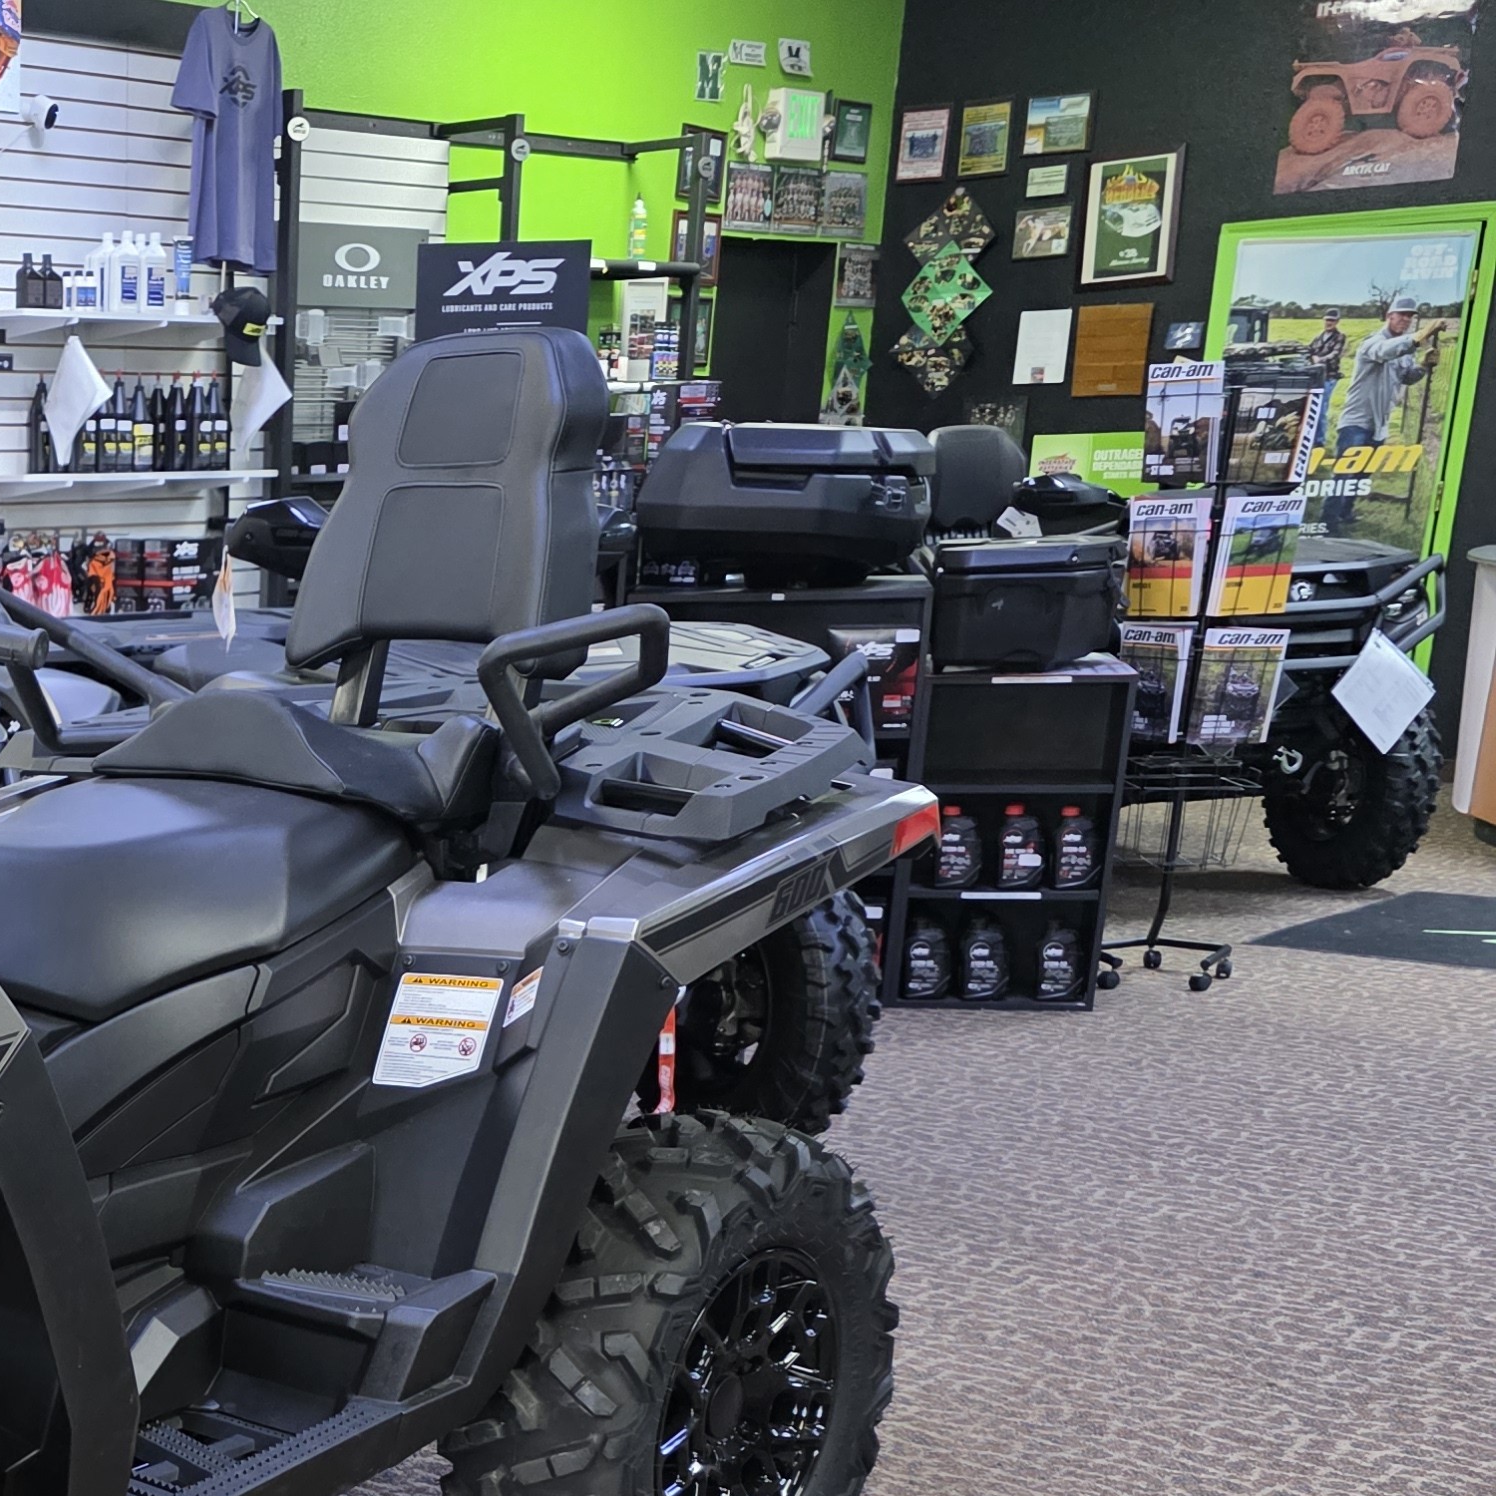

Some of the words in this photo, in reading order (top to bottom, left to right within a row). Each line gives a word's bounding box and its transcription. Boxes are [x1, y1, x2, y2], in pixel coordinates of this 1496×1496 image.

[788, 93, 821, 139] EXIT
[322, 273, 390, 290] OAKLEY
[442, 251, 566, 297] XPS
[441, 304, 483, 313] LUBRICANTS
[484, 303, 498, 312] AND
[499, 303, 517, 311] CARE
[518, 302, 553, 311] PRODUCTS
[1150, 363, 1215, 380] can-am
[1294, 393, 1322, 478] can-am
[1136, 502, 1194, 517] can-am
[1241, 499, 1303, 514] can-am
[1124, 628, 1176, 644] can-am
[1218, 632, 1285, 645] can-am
[428, 977, 489, 988] WARNING
[415, 1017, 476, 1028] WARNING
